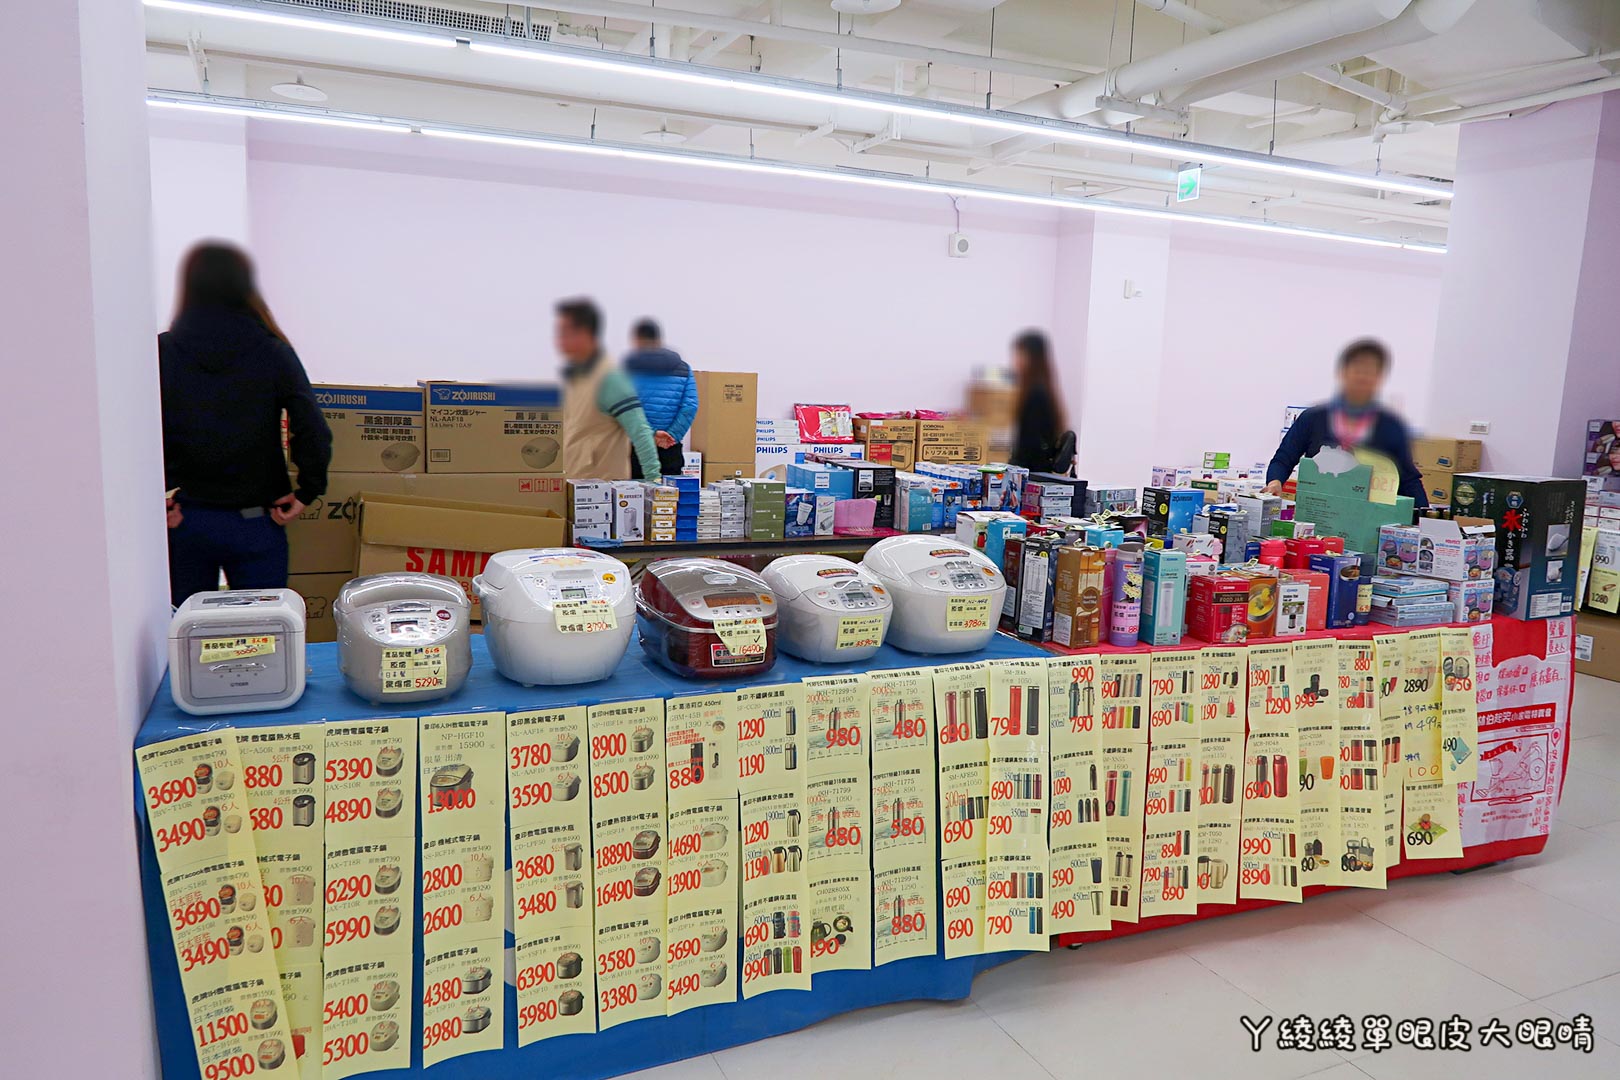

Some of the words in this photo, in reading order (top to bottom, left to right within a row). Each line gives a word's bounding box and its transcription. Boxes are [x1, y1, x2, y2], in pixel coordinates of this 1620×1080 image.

[315, 392, 366, 406] ZOJIRUSHI
[452, 389, 496, 402] ZOJIRUSHI
[757, 446, 788, 454] PHILIPS
[814, 446, 844, 454] PHILIPS
[1594, 554, 1609, 565] 990
[1591, 592, 1608, 604] 1280
[1072, 667, 1094, 682] 990
[1355, 658, 1370, 670] 880
[1152, 679, 1173, 694] 790
[1248, 670, 1270, 689] 1390
[1404, 679, 1428, 692] 2890
[1266, 697, 1291, 714] 1290
[1295, 693, 1316, 710] 990
[762, 709, 781, 719] 2000ml
[1071, 715, 1092, 731] 790
[1152, 710, 1172, 725] 690
[442, 731, 484, 740] NP-HGF10
[685, 721, 702, 729] 1390
[739, 718, 764, 740] 1290
[893, 718, 926, 738] 480
[940, 723, 969, 744] 690
[459, 740, 485, 750] 15900
[592, 734, 626, 760] 8900
[826, 727, 860, 748] 980
[1443, 738, 1457, 754] 490
[512, 744, 551, 769] 3780
[762, 746, 782, 756] 1800ml
[325, 758, 372, 782] 5390
[740, 754, 764, 777] 1190
[1147, 768, 1167, 784] 690
[594, 771, 628, 798] 8500
[670, 766, 704, 788] 880
[1054, 777, 1071, 796] 1090
[149, 777, 196, 808] 3690
[513, 782, 552, 808] 3590
[992, 782, 1012, 800] 690
[1246, 780, 1272, 800] 690
[222, 802, 240, 812] 6人
[325, 798, 371, 822] 4890
[429, 789, 476, 813] 13000
[1145, 798, 1166, 815] 690
[766, 810, 785, 820] 1900ml
[991, 816, 1012, 834] 590
[1052, 809, 1072, 828] 990
[158, 818, 205, 852] 3490
[746, 821, 768, 844] 1290
[826, 826, 860, 847] 680
[891, 817, 924, 838] 580
[944, 819, 973, 843] 690
[1407, 831, 1432, 845] 690
[597, 842, 633, 868] 18890
[669, 833, 701, 860] 14690
[1244, 838, 1271, 854] 990
[424, 864, 462, 893] 2800
[516, 854, 554, 882] 3680
[745, 856, 769, 882] 1190
[1052, 868, 1073, 888] 590
[1142, 868, 1160, 880] 790
[1242, 869, 1270, 885] 890
[325, 875, 371, 904] 6290
[598, 880, 633, 906] 16490
[669, 870, 701, 896] 13900
[988, 880, 1012, 900] 690
[1162, 886, 1184, 900] 690
[519, 891, 556, 920] 3480
[946, 886, 970, 908] 690
[174, 898, 220, 930] 3690
[424, 904, 462, 934] 2600
[1009, 908, 1028, 917] 600ml
[1053, 900, 1074, 917] 490
[325, 916, 370, 946] 5990
[892, 913, 925, 935] 880
[948, 918, 973, 939] 690
[988, 916, 1012, 934] 790
[745, 923, 768, 947] 690
[182, 938, 229, 971] 3490
[667, 938, 701, 963] 5690
[599, 948, 635, 975] 3580
[745, 957, 768, 983] 990
[517, 962, 555, 990] 6390
[424, 978, 462, 1005] 4380
[668, 974, 700, 1000] 5490
[602, 984, 636, 1012] 3380
[324, 994, 368, 1024] 5400
[520, 1000, 556, 1029] 5980
[198, 1013, 248, 1046] 11500
[424, 1017, 462, 1049] 3980
[324, 1033, 368, 1065] 5300
[206, 1054, 254, 1080] 9500
